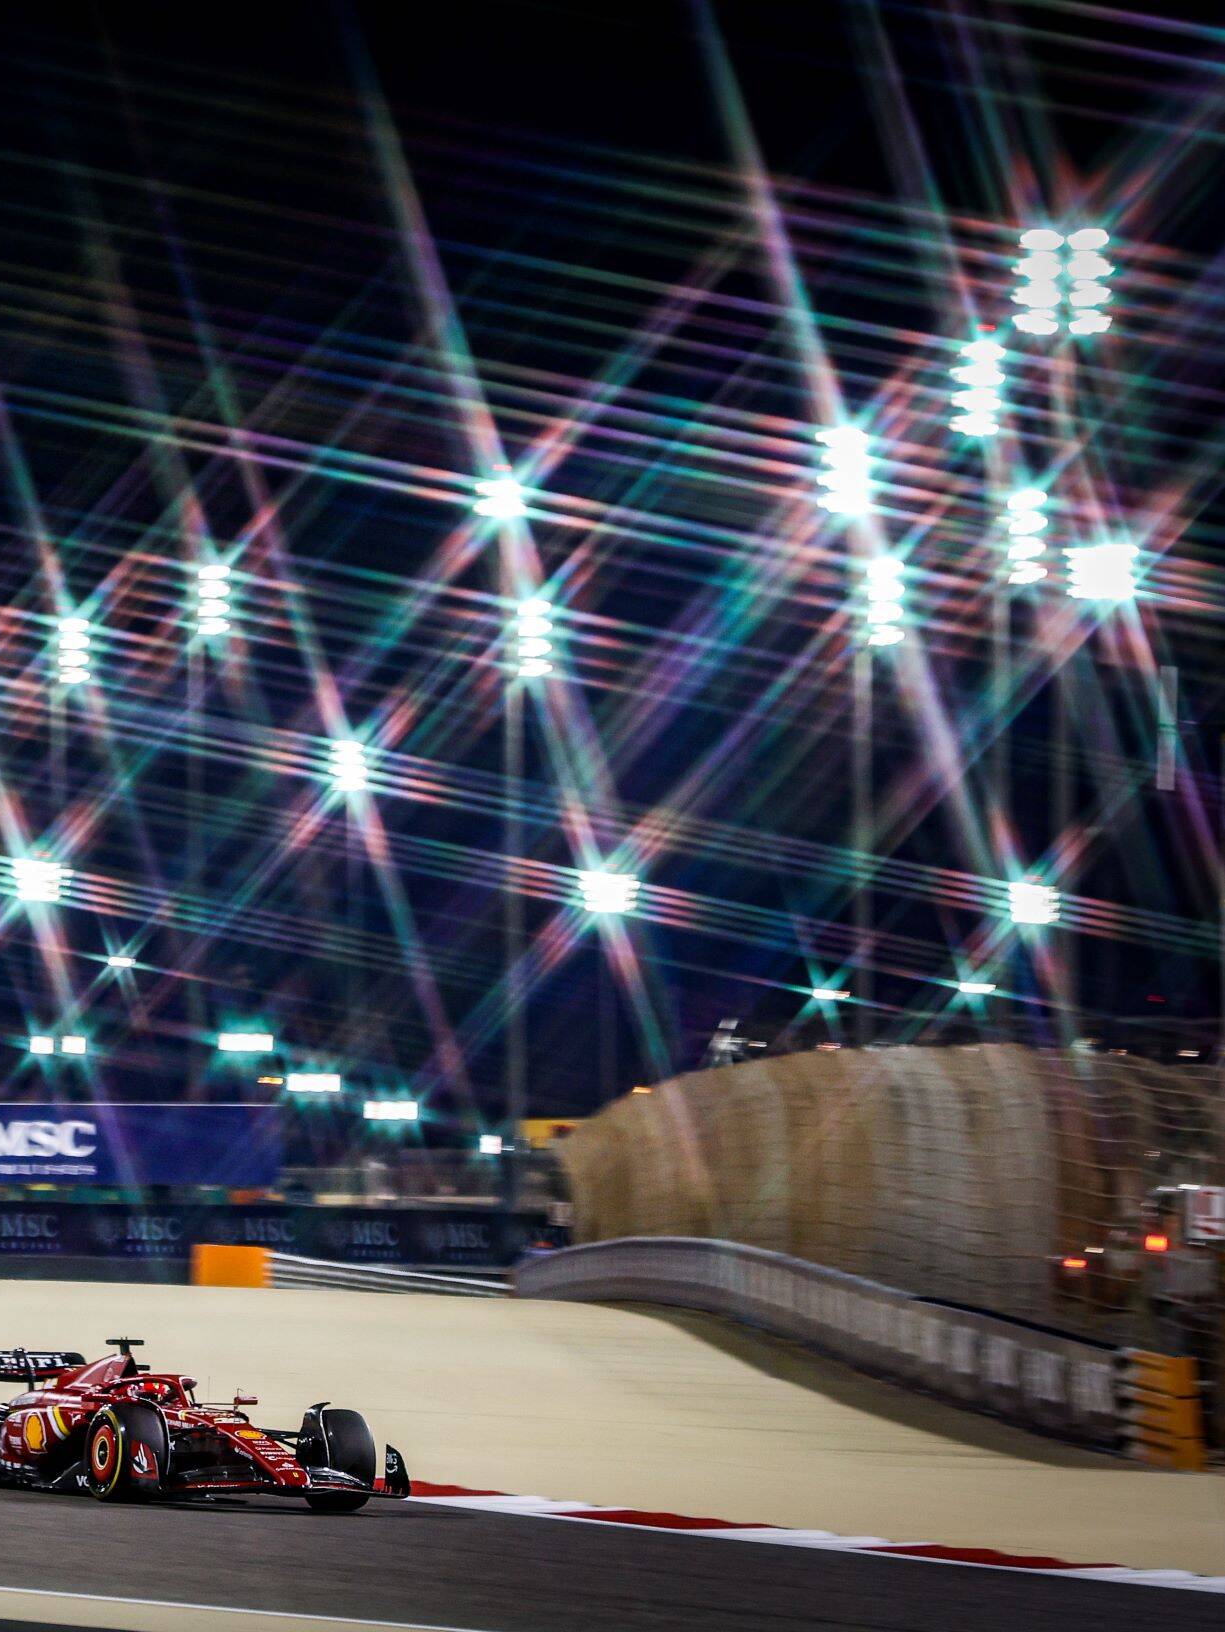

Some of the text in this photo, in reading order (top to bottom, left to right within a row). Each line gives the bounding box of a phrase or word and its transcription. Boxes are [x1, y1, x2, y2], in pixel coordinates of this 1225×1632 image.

[0, 1214, 59, 1238] MSC
[127, 1216, 183, 1241] MSC
[244, 1217, 295, 1242] MSC
[352, 1220, 399, 1246] MSC
